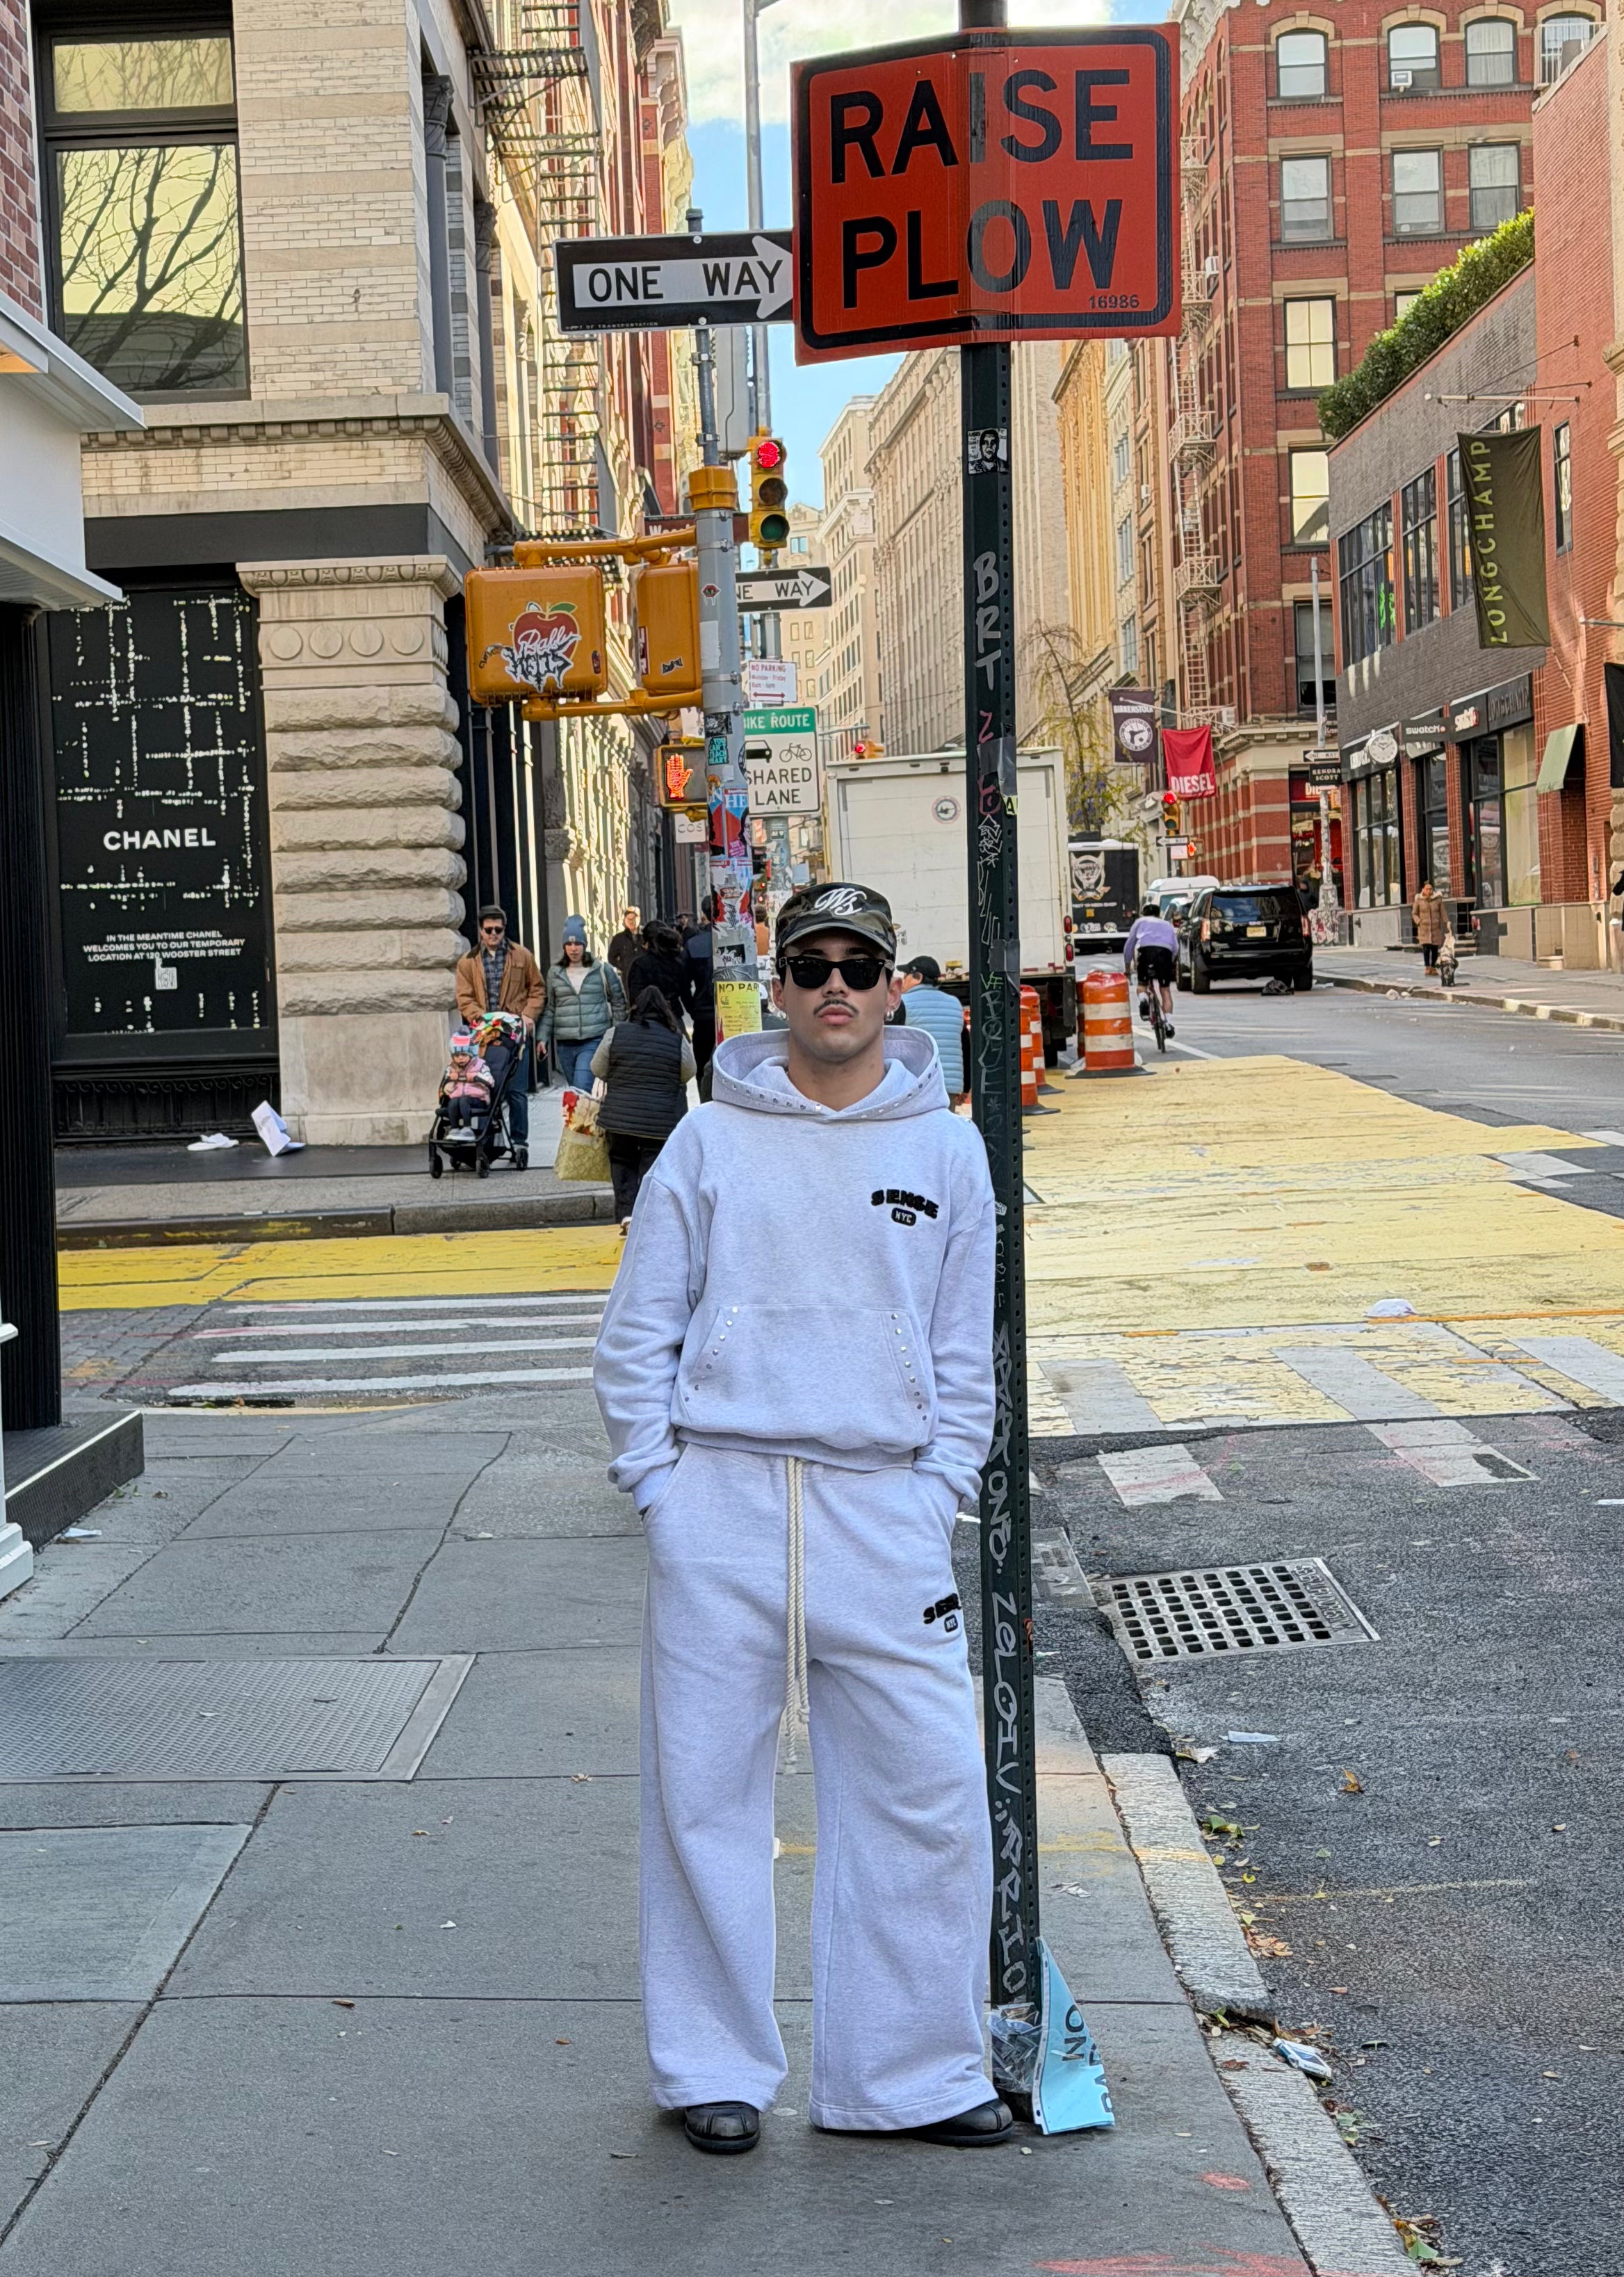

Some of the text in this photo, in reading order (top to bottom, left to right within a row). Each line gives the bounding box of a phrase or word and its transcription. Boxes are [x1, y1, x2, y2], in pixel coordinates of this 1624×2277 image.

[829, 68, 1134, 185] RAISE
[842, 199, 1123, 310] PLOW
[588, 259, 783, 302] ONE WAY
[1087, 294, 1140, 311] 16986
[1470, 441, 1507, 644] LONGCHAMP
[736, 580, 814, 600] NE WAY
[761, 664, 786, 673] PARKING
[771, 713, 810, 728] ROUTE
[1405, 724, 1440, 734] swatch
[747, 768, 813, 785] SHARED
[1171, 772, 1215, 794] DIESEL
[754, 788, 802, 806] LANE
[677, 823, 703, 834] COS
[103, 827, 216, 850] CHANEL
[117, 933, 135, 941] THE
[137, 932, 184, 941] MEANTIME
[186, 930, 222, 939] CHANEL
[83, 943, 135, 953] WELCOMES
[190, 939, 245, 948] TEMPORARY
[88, 953, 132, 962] LOCATION
[161, 950, 206, 959] WOOSTER
[208, 948, 242, 957] STREET
[718, 983, 734, 994] NO
[895, 1210, 913, 1224] NYC
[1062, 2004, 1087, 2061] NO
